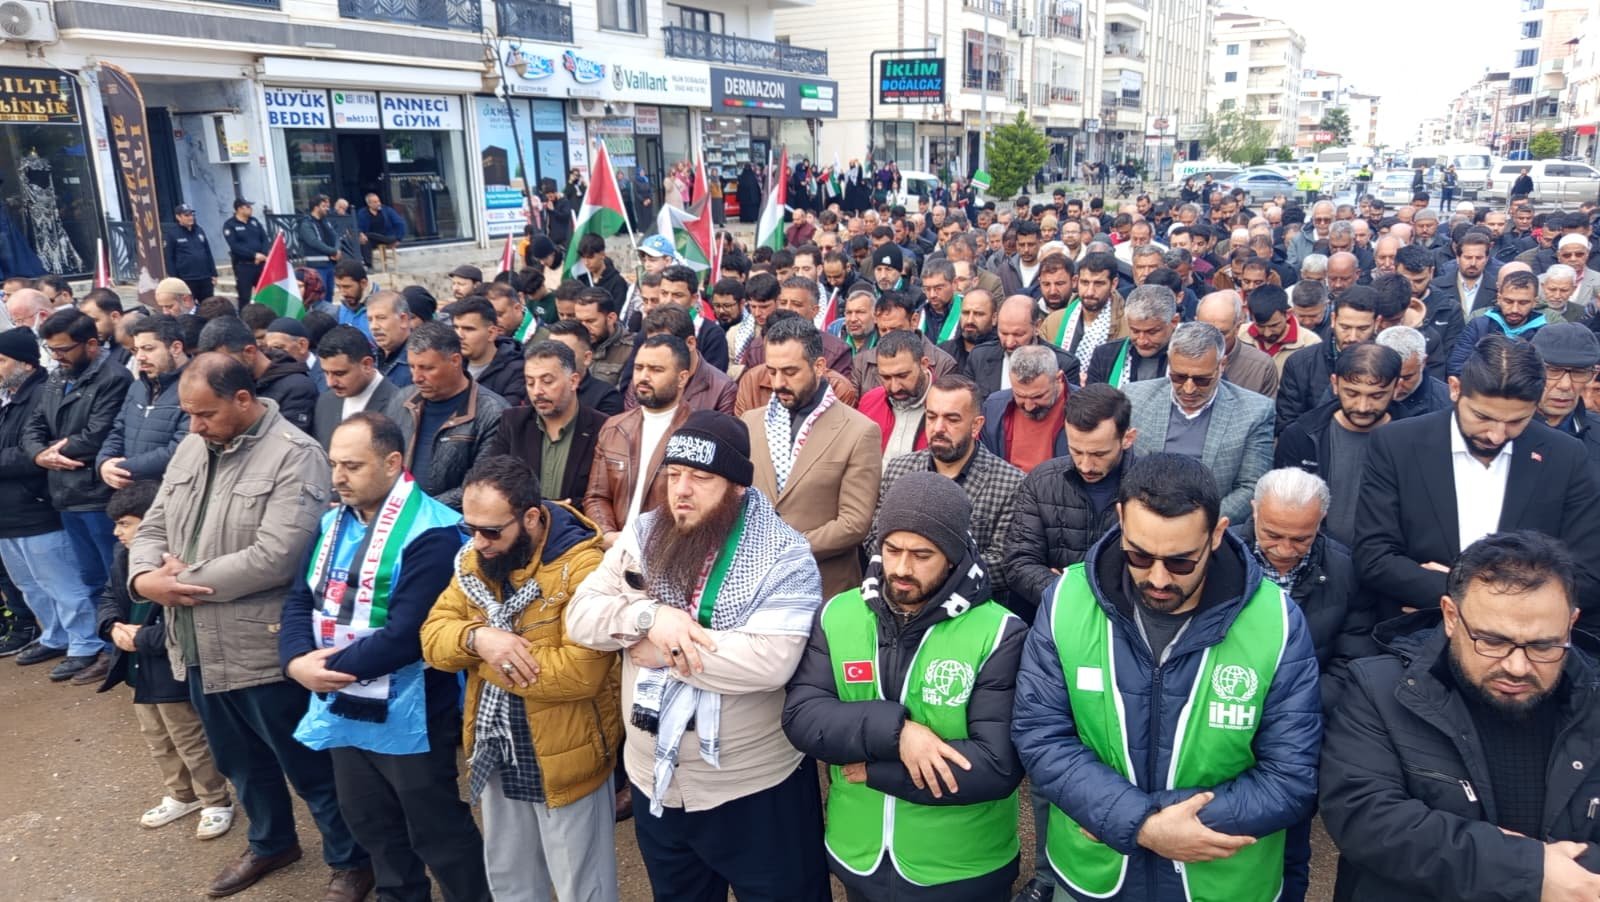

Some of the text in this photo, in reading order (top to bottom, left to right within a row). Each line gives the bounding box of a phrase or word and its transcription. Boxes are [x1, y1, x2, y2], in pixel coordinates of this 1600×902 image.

[886, 61, 938, 77] İKLİM
[624, 69, 668, 92] Vaillant
[724, 77, 785, 99] DERMAZON
[265, 88, 325, 108] BÜYÜK
[384, 97, 449, 112] ANNECİ
[269, 111, 325, 126] BEDEN
[393, 111, 441, 128] GİYİM
[357, 495, 405, 605] PALESTINE
